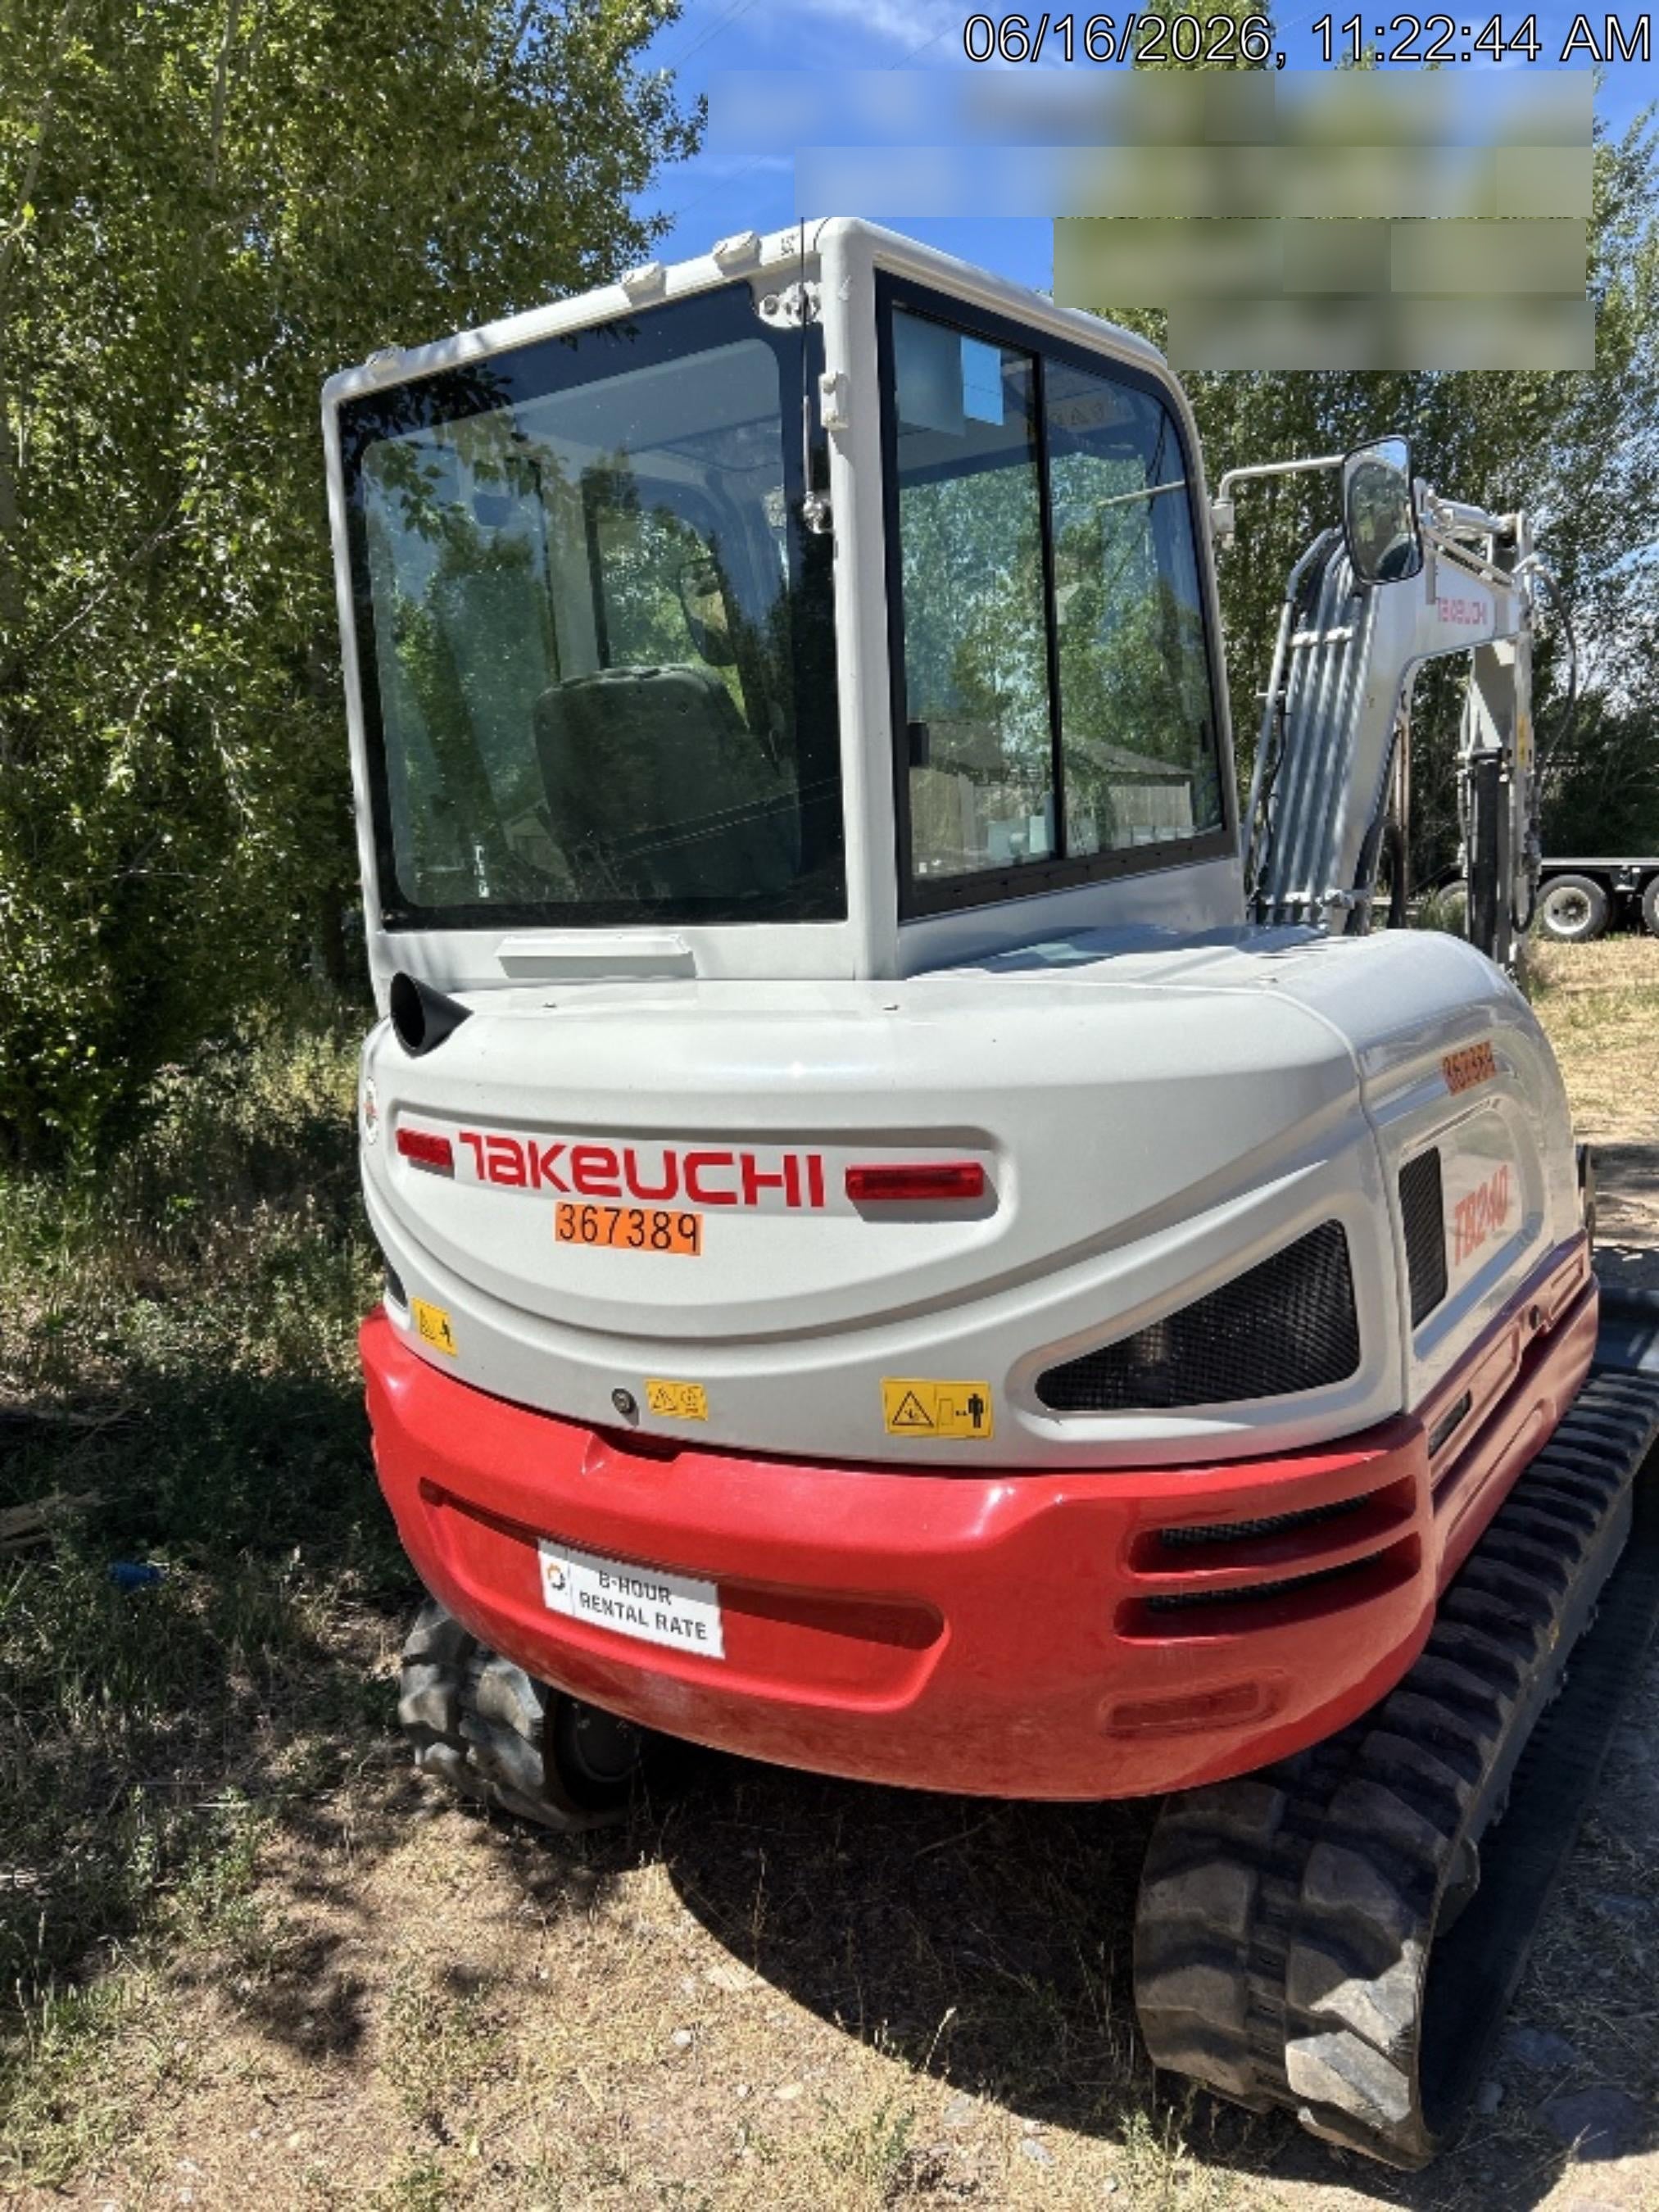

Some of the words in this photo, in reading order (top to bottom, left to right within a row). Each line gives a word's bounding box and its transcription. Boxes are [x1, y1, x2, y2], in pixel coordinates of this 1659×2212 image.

[560, 1203, 698, 1253] 367389
[579, 1591, 649, 1627] RENTAL
[655, 1611, 708, 1639] RATE
